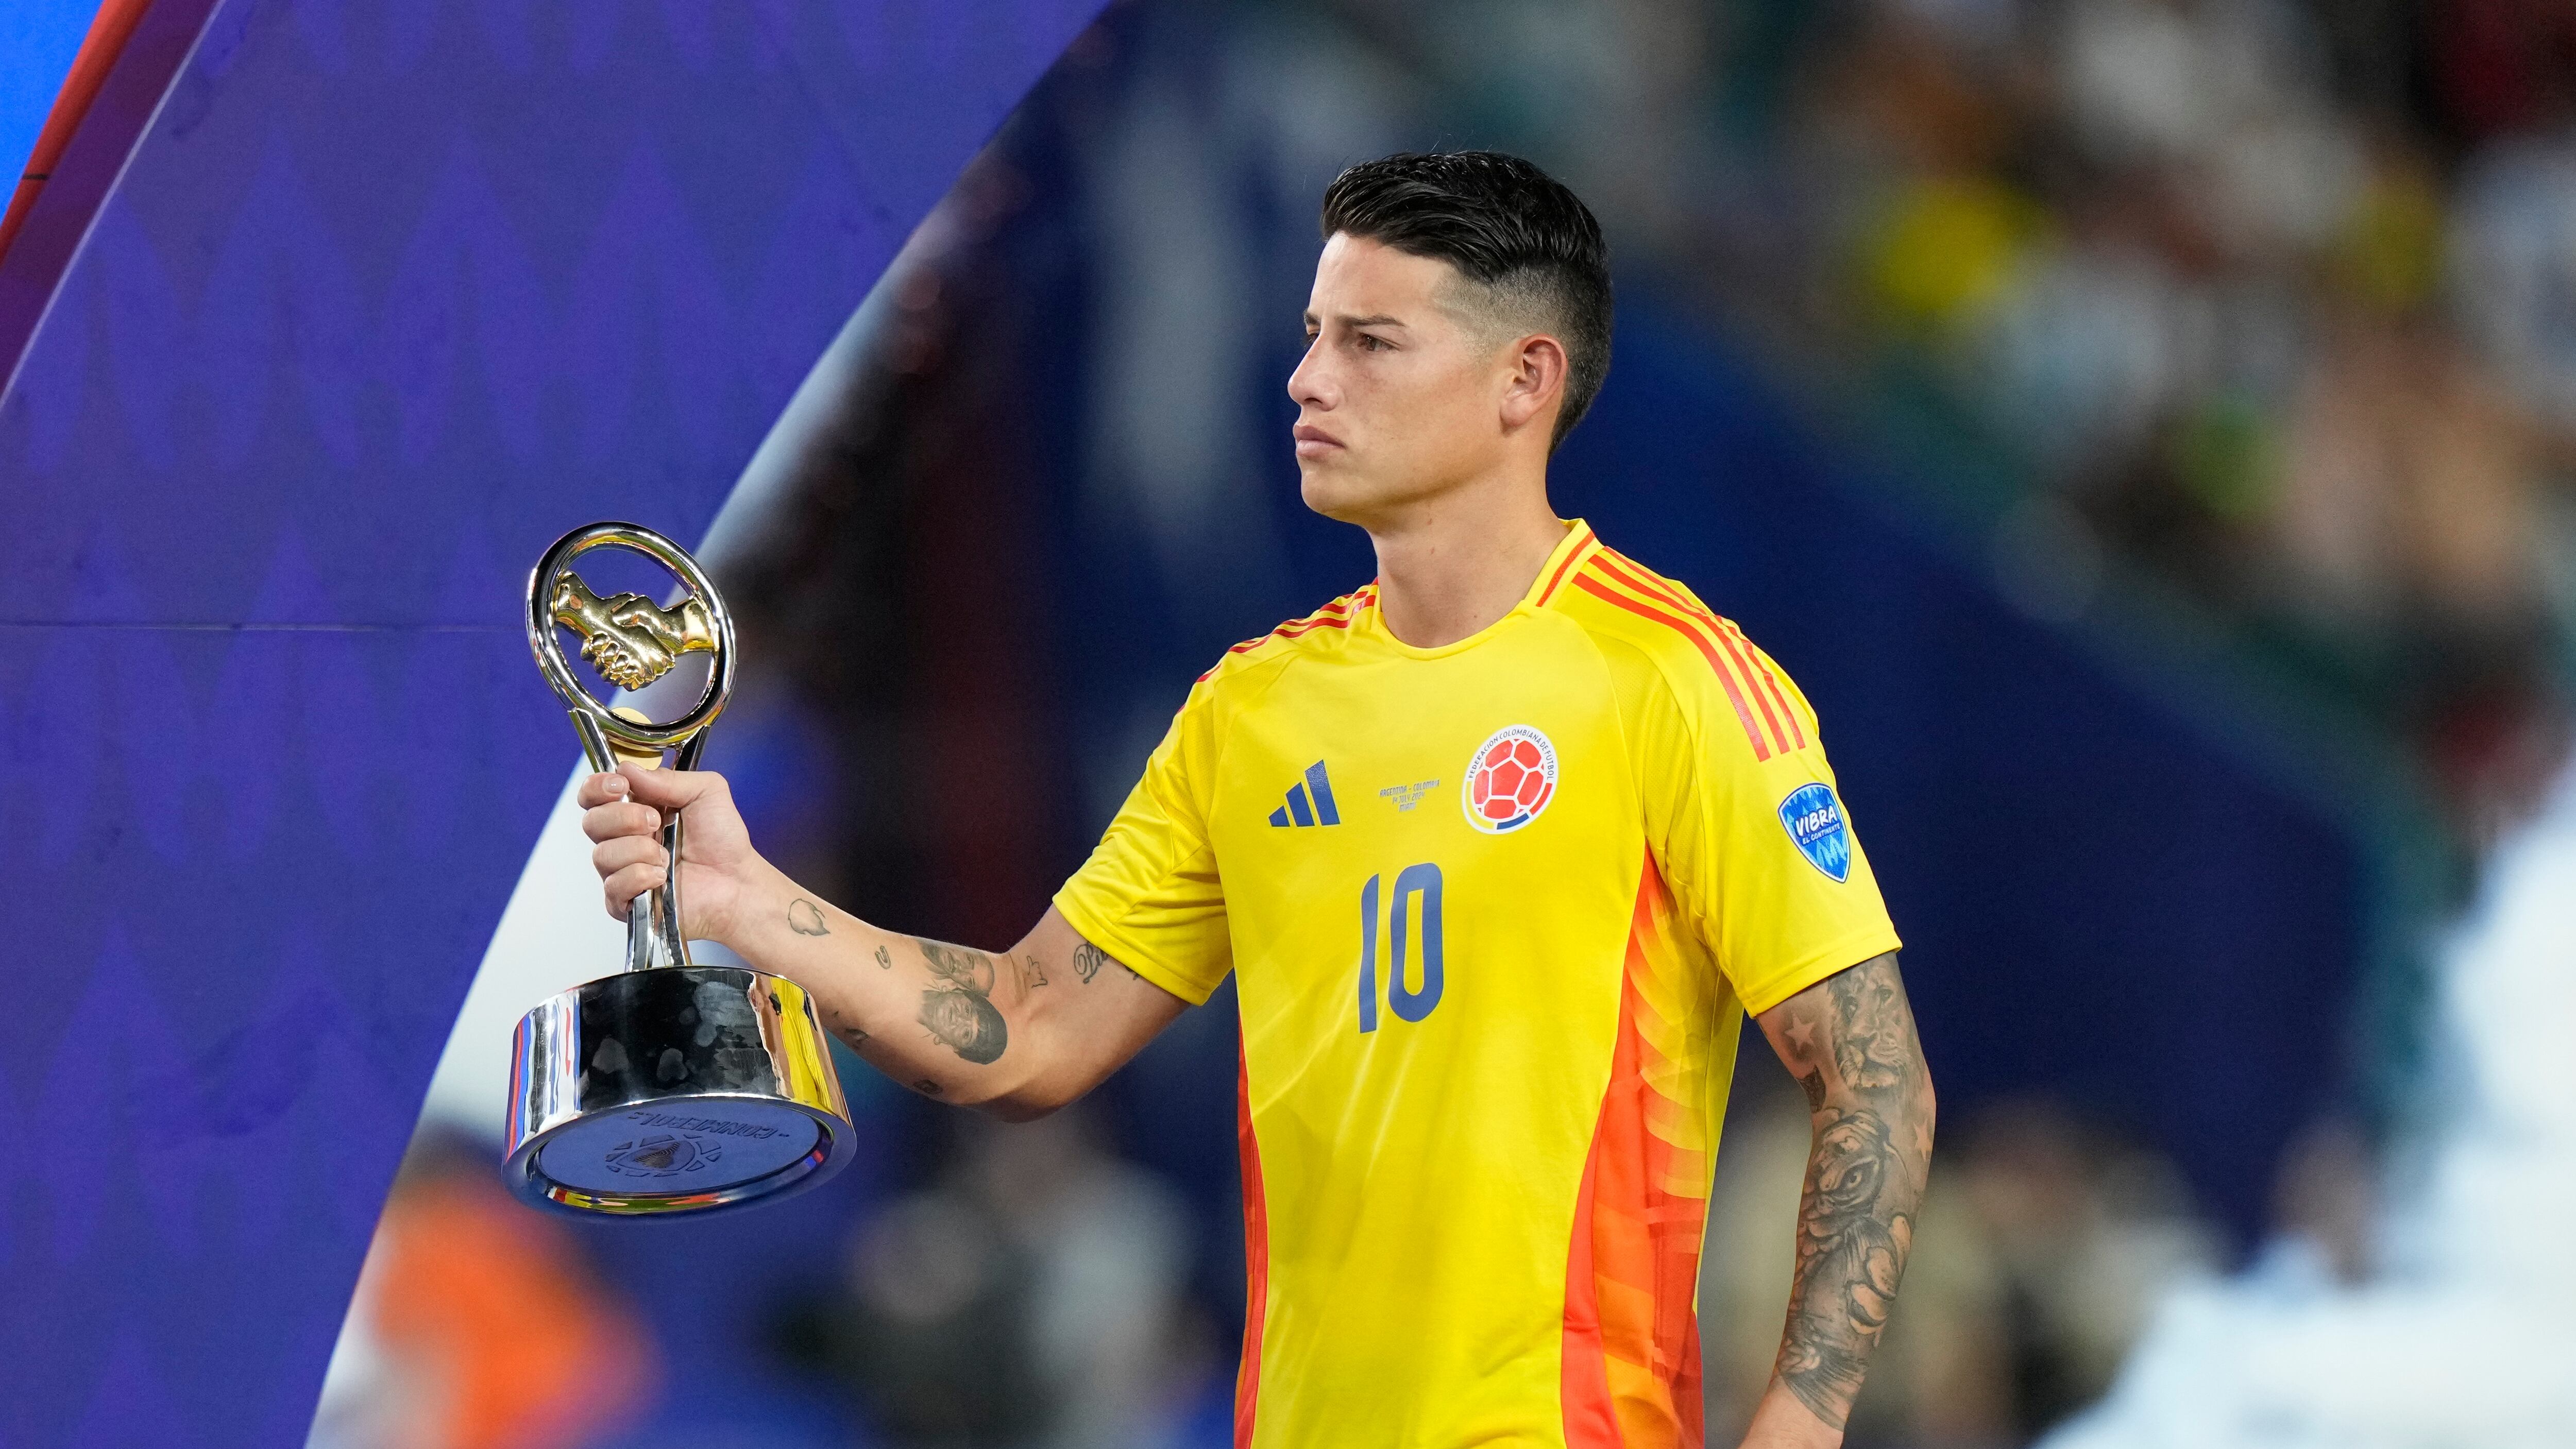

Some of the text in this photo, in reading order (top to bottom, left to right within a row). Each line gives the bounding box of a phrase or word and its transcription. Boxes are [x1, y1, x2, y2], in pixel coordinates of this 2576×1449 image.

[1499, 729, 1541, 744] COLOMBIANA
[1539, 741, 1548, 752] DE
[1379, 785, 1407, 797] ARGENTINA
[1398, 793, 1411, 804] JULY
[1795, 805, 1838, 837] VIBRA
[1810, 822, 1841, 842] CONTINENTE
[1358, 862, 1444, 1034] 10
